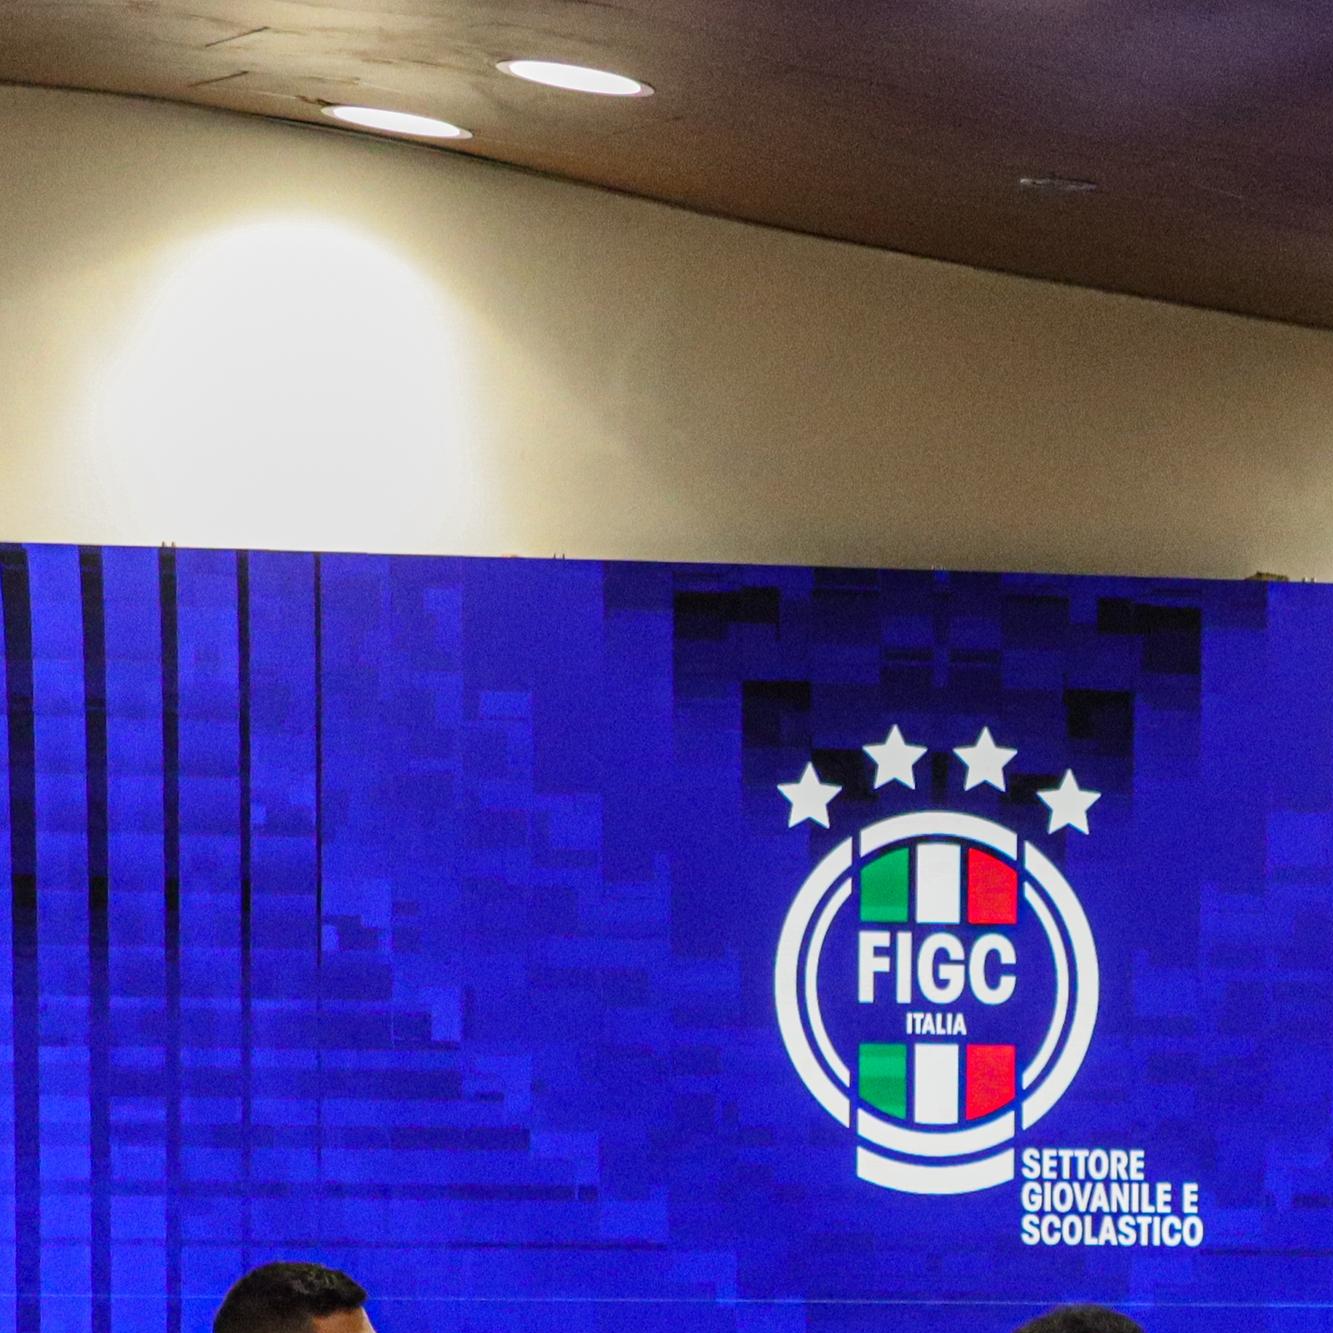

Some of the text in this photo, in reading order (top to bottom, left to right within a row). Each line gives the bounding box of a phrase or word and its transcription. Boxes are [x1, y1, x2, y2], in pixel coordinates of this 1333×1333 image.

[858, 930, 1017, 1005] FIGC
[906, 1012, 967, 1035] ITALIA
[1021, 1147, 1145, 1180] SETTORE
[1021, 1181, 1199, 1213] GIOVANILE E
[1021, 1214, 1204, 1247] SCOLASTICO
